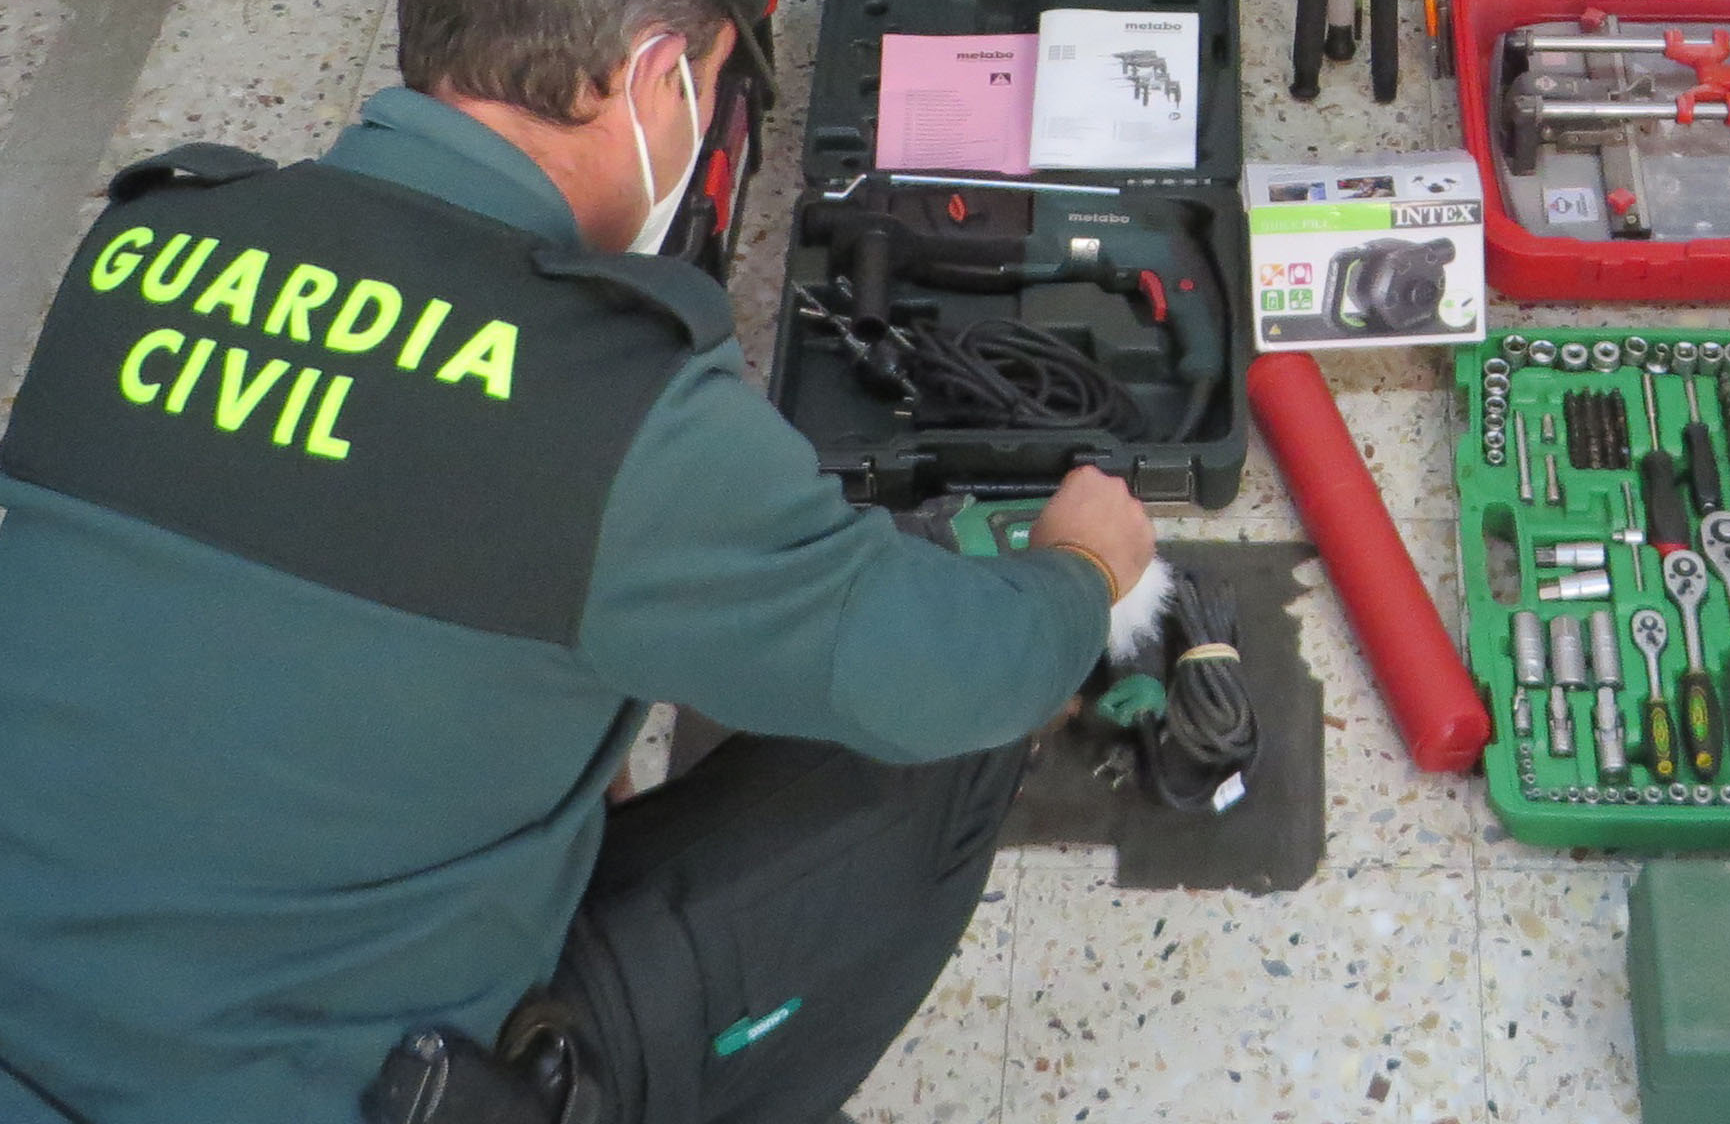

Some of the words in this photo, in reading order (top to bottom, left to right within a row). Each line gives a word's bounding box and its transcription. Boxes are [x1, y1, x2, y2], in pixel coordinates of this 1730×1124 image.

[1124, 21, 1183, 32] metabo
[956, 50, 1014, 61] metabo
[1068, 212, 1130, 224] metabo
[1395, 203, 1478, 227] INTEX
[90, 226, 519, 401] GUARDIA
[119, 328, 354, 461] CIVIL
